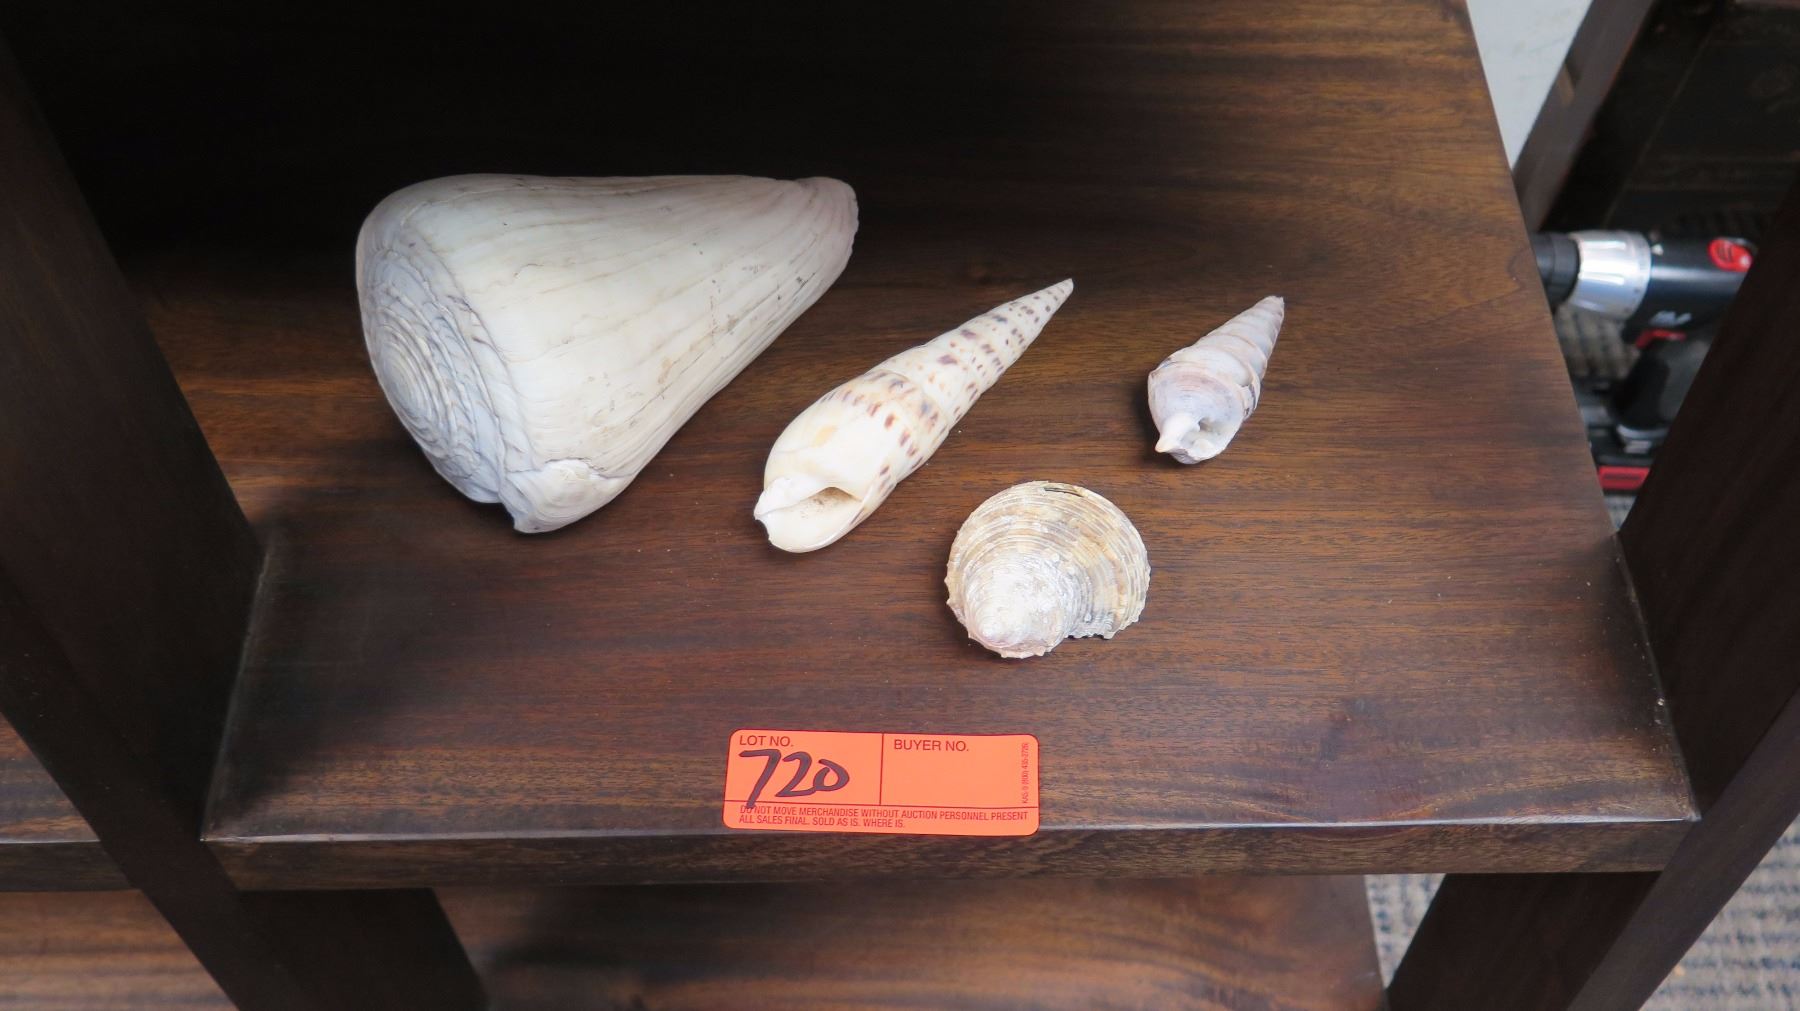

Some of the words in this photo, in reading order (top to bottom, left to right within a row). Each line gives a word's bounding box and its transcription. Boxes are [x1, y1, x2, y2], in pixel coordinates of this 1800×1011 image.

[739, 735, 767, 746] LOT
[770, 736, 794, 747] NO.
[893, 739, 941, 751] BUYER
[945, 740, 969, 752] NO.
[738, 748, 850, 809] 720
[754, 805, 772, 815] NOT
[773, 806, 796, 816] MOVE
[799, 807, 859, 818] MERCHANDISE
[861, 808, 899, 818] WITHOUT
[901, 810, 938, 820] AUCTION
[940, 811, 989, 821] PERSONNEL
[991, 811, 1028, 821] PRESENT
[739, 814, 756, 824] ALL
[756, 815, 783, 825] SALES
[784, 816, 809, 826] FINAL.
[812, 817, 836, 826] SOLD
[836, 817, 848, 826] AS
[863, 818, 893, 828] WHERE
[895, 819, 906, 829] IS.
